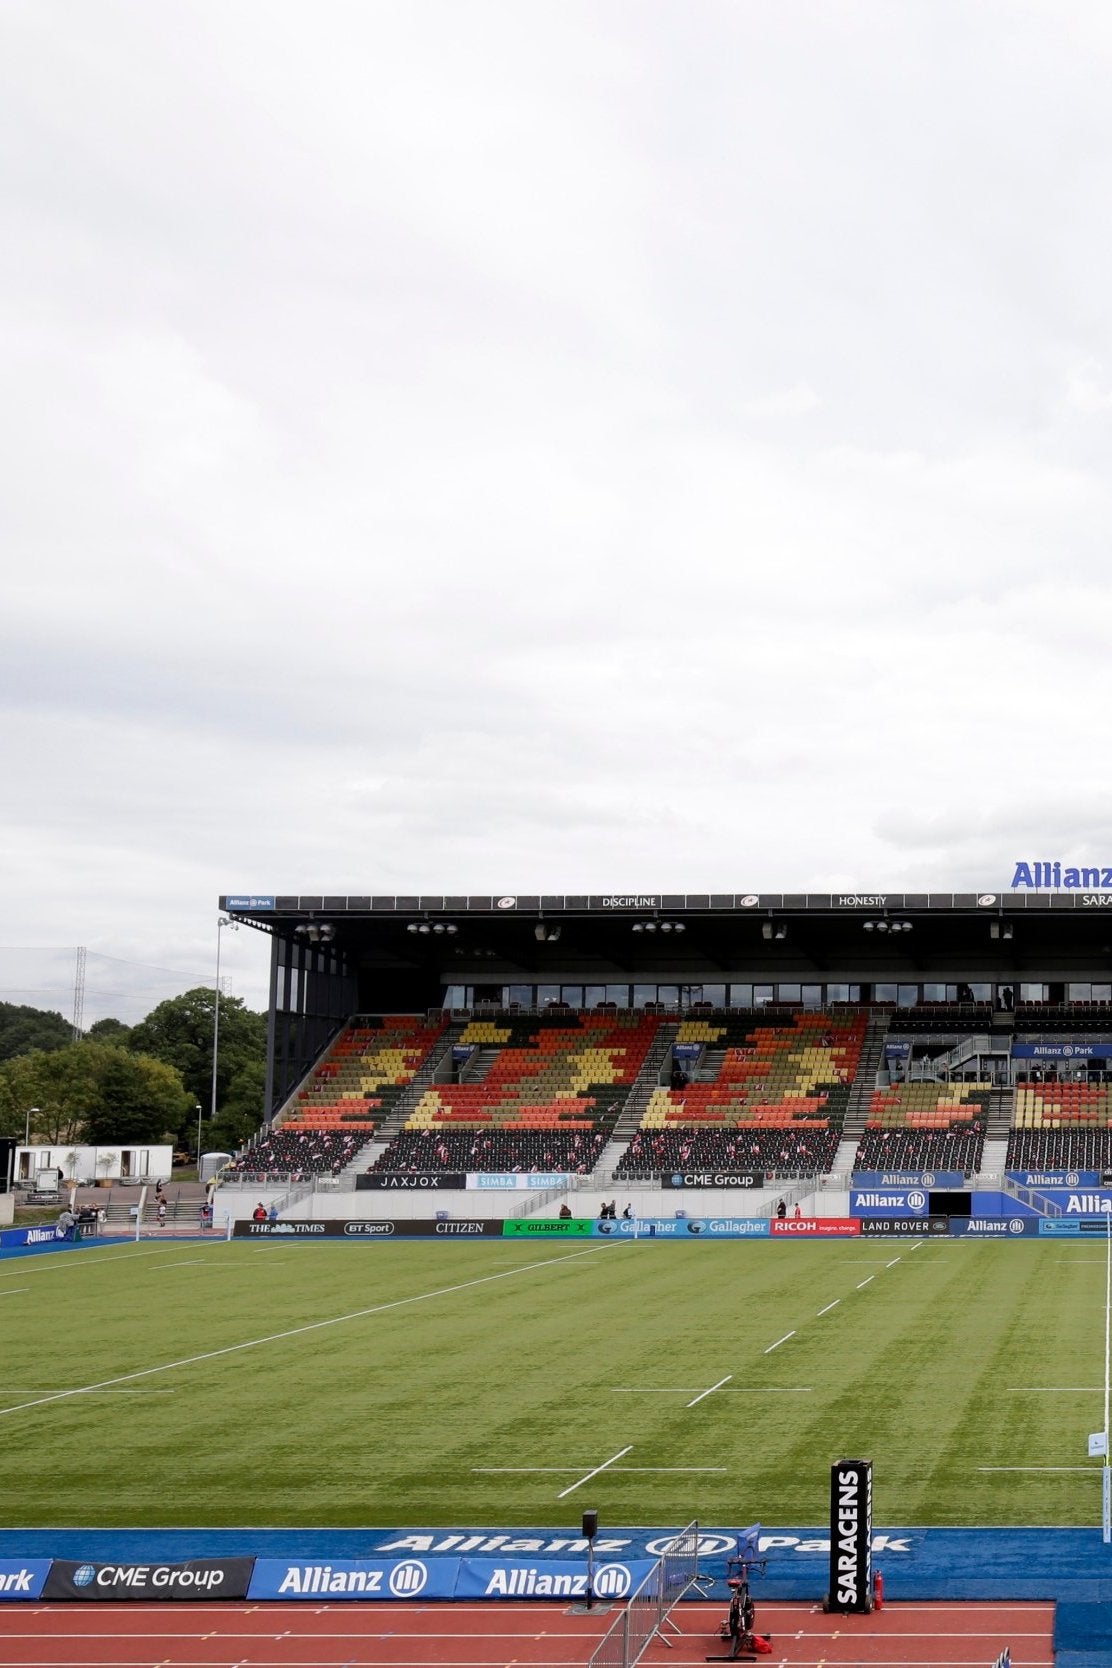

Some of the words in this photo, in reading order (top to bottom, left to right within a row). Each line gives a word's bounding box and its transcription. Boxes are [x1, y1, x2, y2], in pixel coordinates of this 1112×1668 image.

[602, 897, 656, 907] DISCIPLINE
[839, 896, 887, 906] HONESTY
[1033, 1046, 1062, 1055] Allianz
[1074, 1046, 1094, 1055] Park
[380, 1177, 439, 1187] JAXJOX
[480, 1177, 514, 1187] SIMBA
[530, 1177, 563, 1187] SIMBA
[684, 1174, 713, 1186] CME
[714, 1174, 754, 1187] Group
[881, 1175, 919, 1185] Allianz
[1026, 1174, 1064, 1185] Allianz
[856, 1194, 905, 1207] Allianz
[250, 1224, 272, 1233] THE
[295, 1224, 325, 1233] TIMES
[349, 1224, 363, 1232] BT
[364, 1223, 389, 1233] Sport
[436, 1223, 484, 1233] CITIZEN
[527, 1223, 570, 1232] GILBERT
[709, 1221, 766, 1233] Gallagher
[774, 1222, 817, 1231] RICOH
[862, 1222, 890, 1231] LAND
[894, 1222, 929, 1231] ROVER
[967, 1220, 1007, 1231] Allianz
[27, 1230, 54, 1243] Allianz
[837, 1470, 859, 1604] SARACENS
[375, 1535, 632, 1552] Allianz
[758, 1535, 913, 1552] Pak
[97, 1566, 150, 1587] CME
[151, 1566, 225, 1590] Group
[278, 1567, 383, 1593] Allianz
[485, 1568, 590, 1595] Allianz
